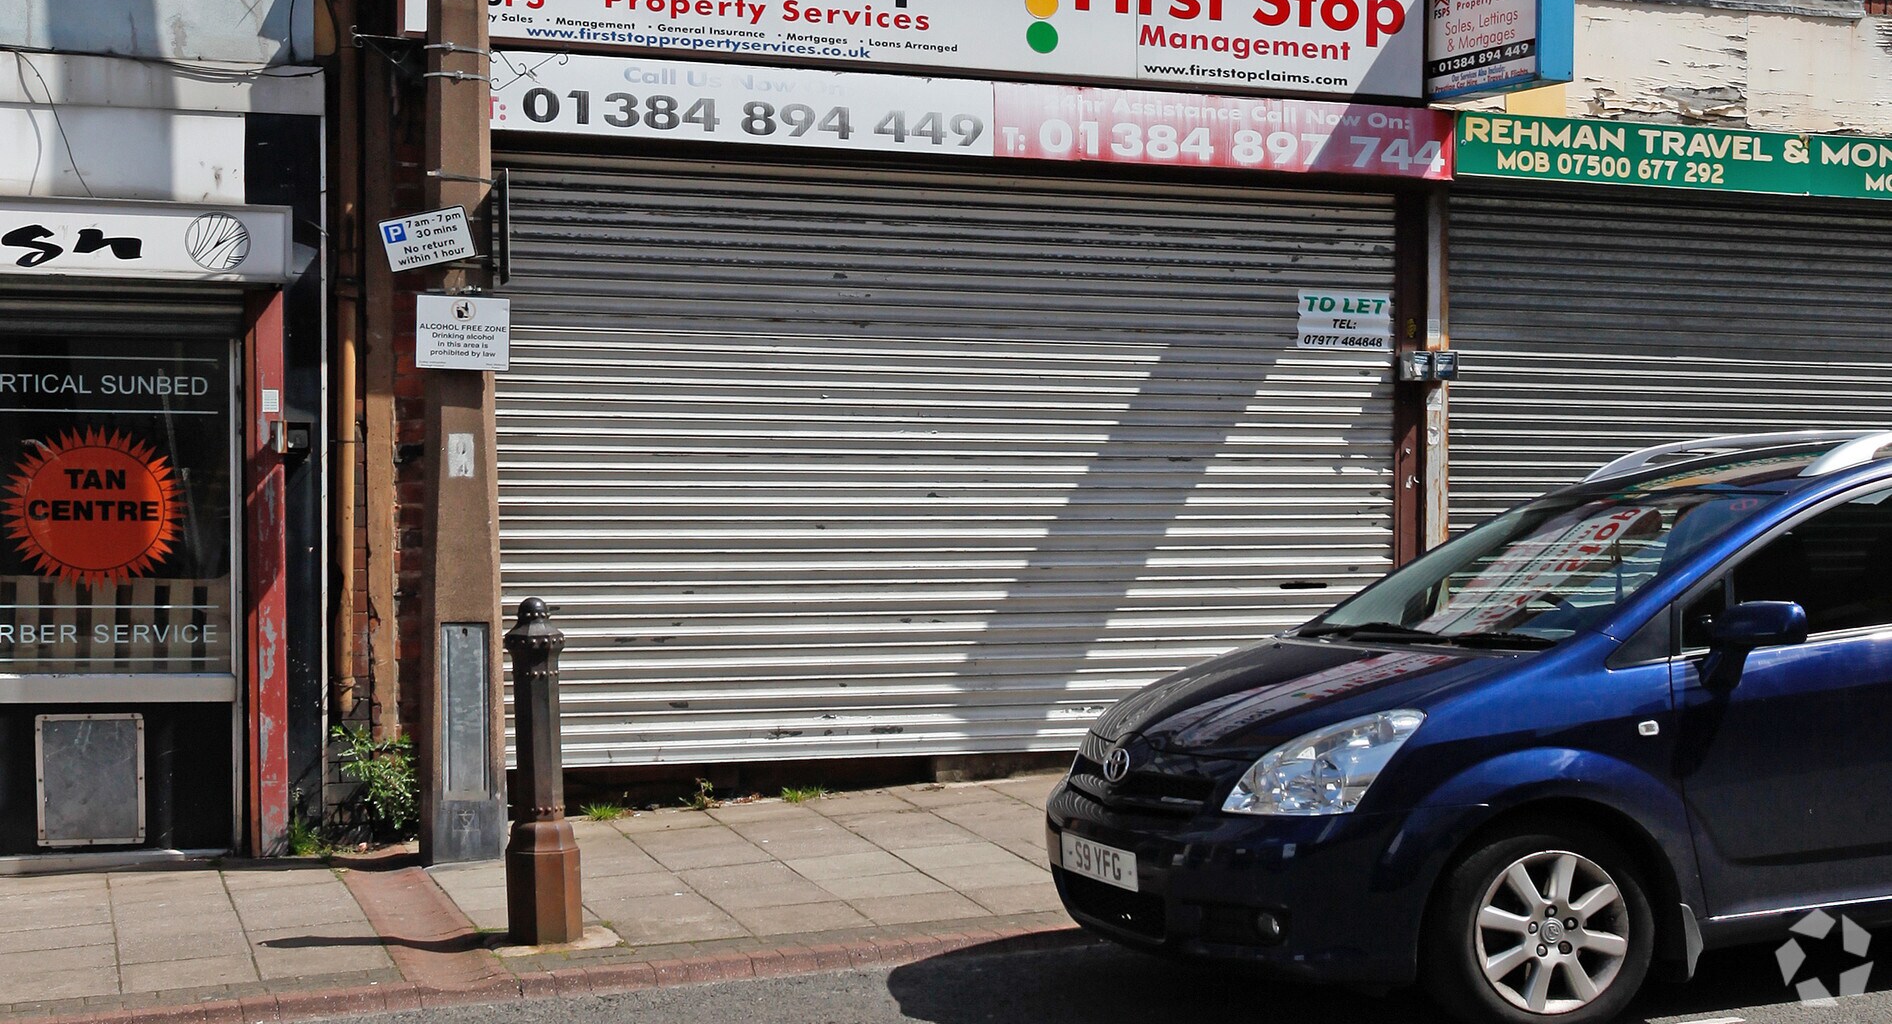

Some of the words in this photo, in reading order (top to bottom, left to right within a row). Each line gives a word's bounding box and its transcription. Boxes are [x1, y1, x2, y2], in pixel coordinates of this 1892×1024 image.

[782, 0, 930, 31] Services
[1433, 6, 1451, 19] FSPS
[1445, 18, 1475, 36] Sales,
[1479, 10, 1519, 29] Lettings
[501, 13, 534, 24] Sales
[555, 16, 636, 31] Management
[657, 23, 705, 35] General
[709, 25, 766, 39] Insurance
[786, 32, 848, 46] Mortgages
[868, 38, 901, 49] Loans
[904, 40, 958, 53] Arranged
[526, 27, 871, 59] www.firststoppropertyservices.co.uk
[1139, 23, 1350, 61] Management
[1447, 38, 1455, 52] &
[1458, 28, 1516, 49] Mortgages
[1438, 55, 1475, 72] 01384
[1478, 49, 1502, 63] 894
[1504, 42, 1529, 57] 449
[623, 66, 676, 86] Call
[1144, 62, 1349, 87] www.firststopclaims.com
[522, 87, 721, 133] 01384
[741, 100, 855, 141] 894
[873, 109, 984, 147] 449
[1112, 97, 1243, 121] Assistance
[1251, 105, 1297, 124] Call
[1306, 108, 1361, 126] Now
[1367, 112, 1411, 130] On:
[1002, 126, 1026, 152] T:
[1039, 118, 1215, 161] 01384
[1231, 129, 1333, 167] 897
[1350, 135, 1446, 173] 744
[1465, 116, 1626, 152] REHMAN
[1638, 129, 1773, 162] TRAVEL
[1782, 139, 1810, 164] &
[1497, 148, 1550, 173] MOB
[1557, 153, 1631, 179] 07500
[1638, 158, 1679, 181] 677
[1684, 161, 1725, 185] 292
[416, 228, 431, 239] 30
[433, 224, 458, 235] mins
[398, 253, 431, 266] within
[434, 251, 439, 259] 1
[442, 247, 465, 258] hour
[404, 245, 419, 254] No
[422, 238, 455, 251] return
[1303, 295, 1336, 313] TO
[1342, 297, 1387, 315] LET
[419, 322, 460, 331] ALCOHOL
[461, 324, 483, 332] FREE
[484, 325, 507, 333] ZONE
[1332, 318, 1357, 330] TEL:
[431, 331, 465, 341] Drinking
[466, 333, 495, 341] alcohol
[446, 340, 461, 348] this
[1303, 334, 1341, 346] 07977
[1341, 336, 1383, 348] 484848
[429, 349, 470, 357] prohibited
[471, 350, 481, 358] by
[482, 350, 496, 358] law
[0, 373, 92, 394] RTICAL
[100, 374, 209, 396] SUNBED
[64, 468, 127, 491] TAN
[28, 499, 160, 522] CENTRE
[0, 624, 78, 644] RBER
[93, 624, 218, 644] SERVICE
[1075, 840, 1092, 871] S9
